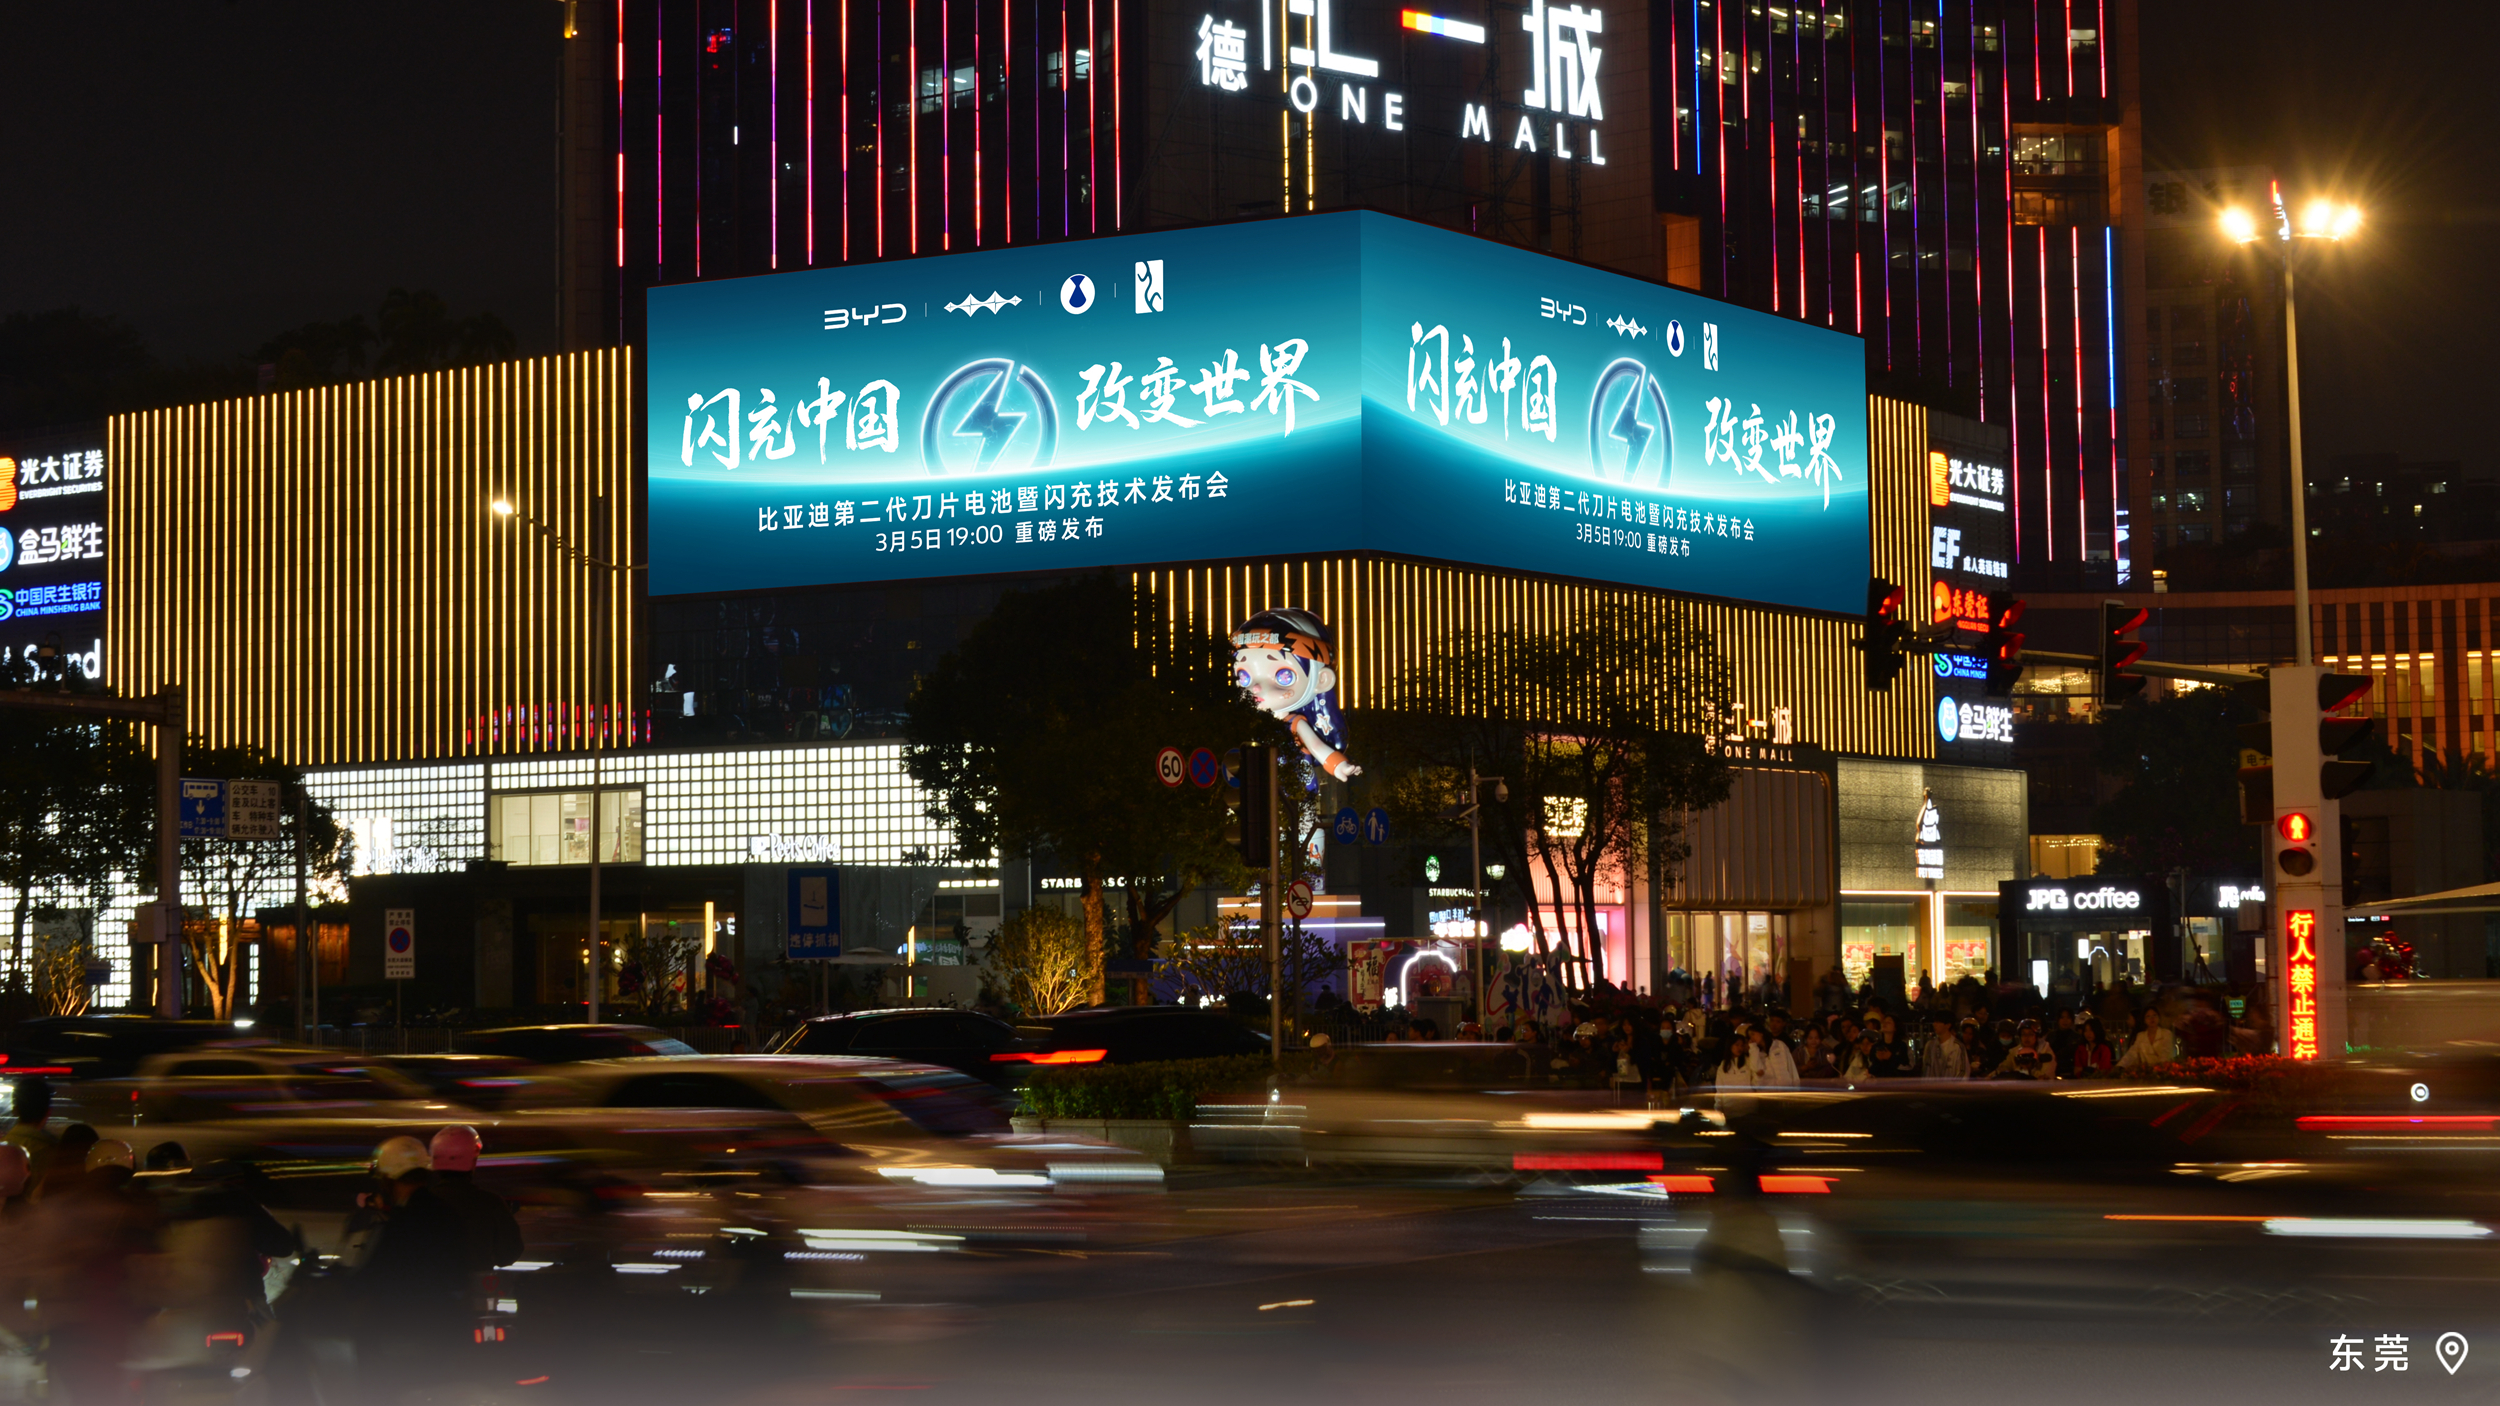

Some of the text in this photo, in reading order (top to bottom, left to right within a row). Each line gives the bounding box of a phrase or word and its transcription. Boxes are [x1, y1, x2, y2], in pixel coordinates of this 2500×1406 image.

[1196, 14, 1247, 92] 德
[1290, 76, 1606, 165] ONE MALL
[823, 302, 908, 331] BYD
[1540, 296, 1587, 326] BYD
[680, 338, 1321, 471] 闪充中国 改变世界
[1406, 320, 1843, 512] 闪充中国 改变世界
[20, 449, 104, 485] 光大证券
[1949, 459, 2005, 495] 光大证券
[19, 486, 62, 500] EVERBRIGHT
[757, 470, 1230, 532] 比亚迪第二代刀片电池暨闪充技术发布会
[1504, 478, 1756, 542] 比亚迪第二代刀片电池暨闪充技术发布会
[18, 522, 104, 565] 盒马鲜生
[875, 516, 1105, 553] 3月5日19:00 重磅发布
[1575, 522, 1691, 558] 3月5日19:00 重磅发布
[1932, 525, 1961, 570] EF
[1962, 555, 2008, 579] 成人英语培训
[15, 581, 102, 606] 中国民生银行
[15, 601, 102, 617] CHINA MINSHENG BANK
[1953, 667, 1970, 678] CHINA
[1958, 702, 2014, 743] 盒马鲜生
[1161, 755, 1182, 778] 60
[1724, 745, 1793, 762] ONE MALL
[232, 797, 276, 809] 座及以上客
[231, 824, 276, 836] 辆允许驶入
[803, 834, 841, 863] Coffee
[2026, 886, 2141, 911] JPG coffee
[2289, 912, 2319, 1061] 行人禁止通行
